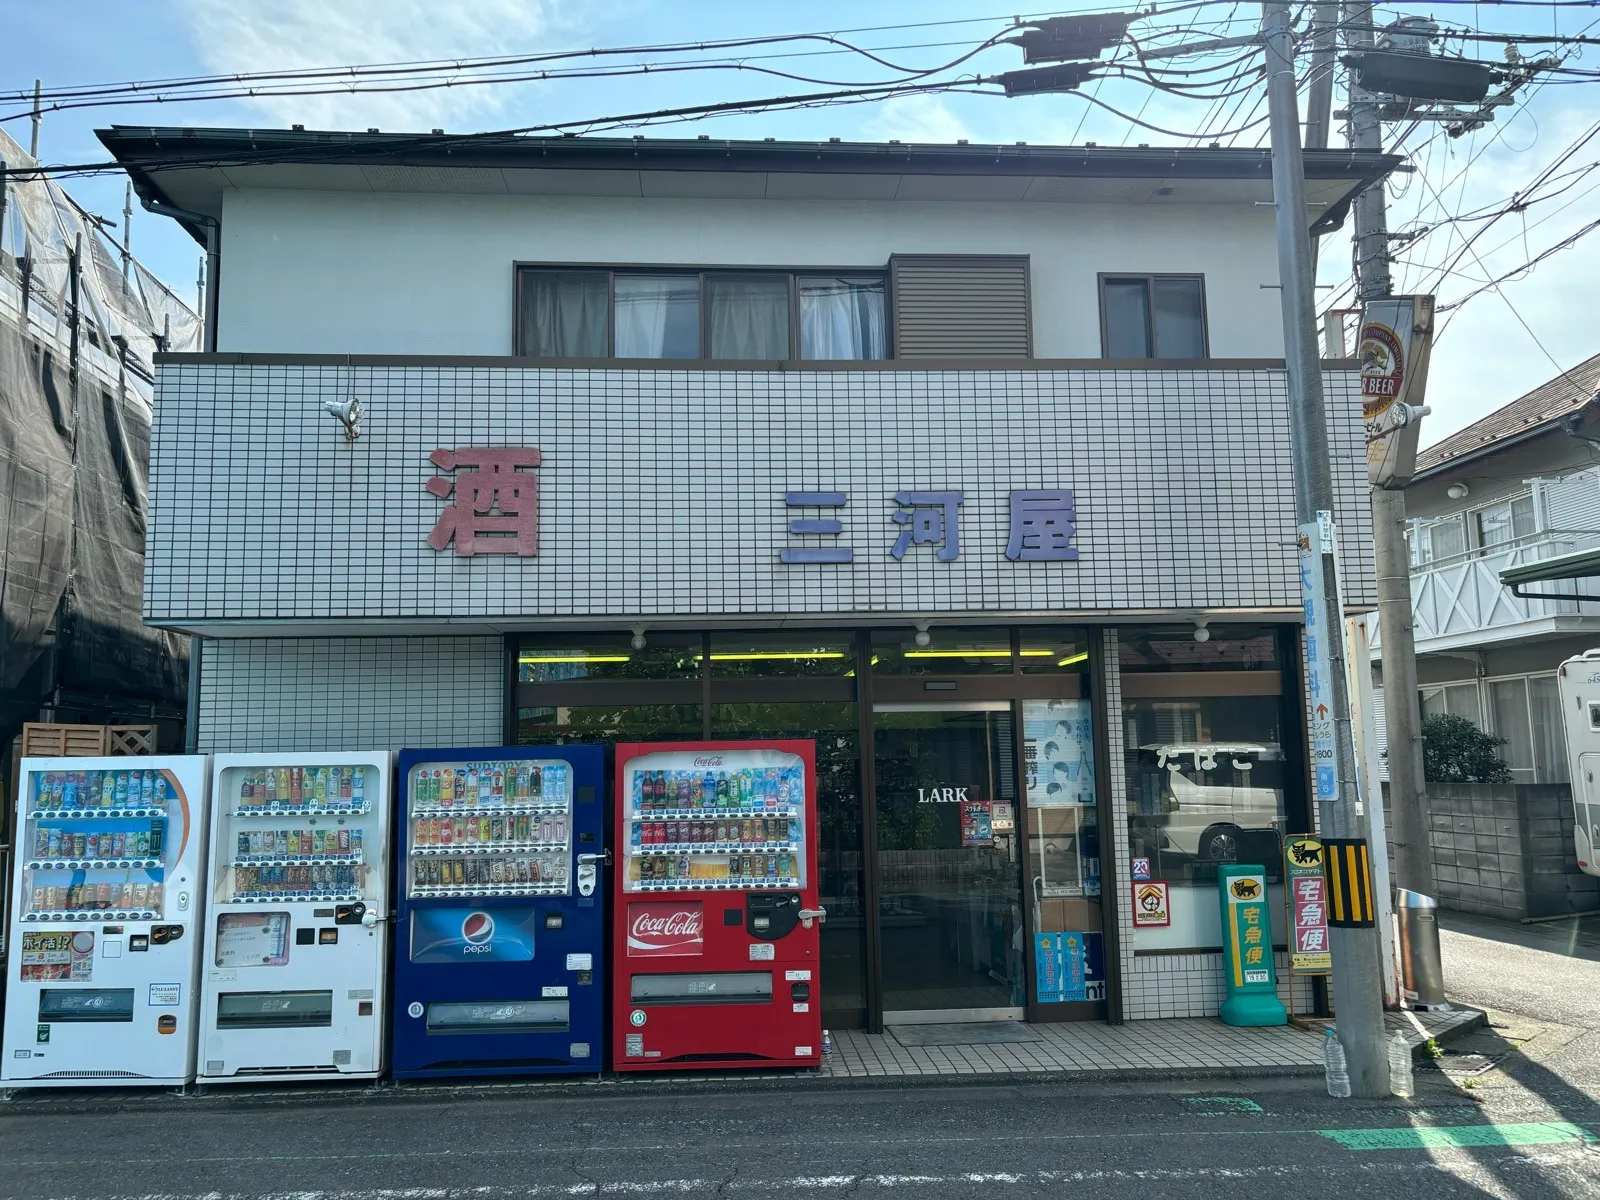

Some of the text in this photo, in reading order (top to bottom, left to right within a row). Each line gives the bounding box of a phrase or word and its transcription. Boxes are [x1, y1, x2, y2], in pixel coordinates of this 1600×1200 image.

[1369, 378, 1394, 395] BEER
[426, 447, 541, 559] 酒
[779, 489, 1080, 565] 三河屋
[1156, 746, 1253, 771] たばこ
[918, 787, 969, 803] LARK
[1133, 861, 1148, 874] 20
[632, 911, 703, 937] Coca-Cola
[1298, 880, 1325, 951] 宅急便
[1242, 906, 1264, 965] 宅急便
[463, 944, 492, 955] pepsi
